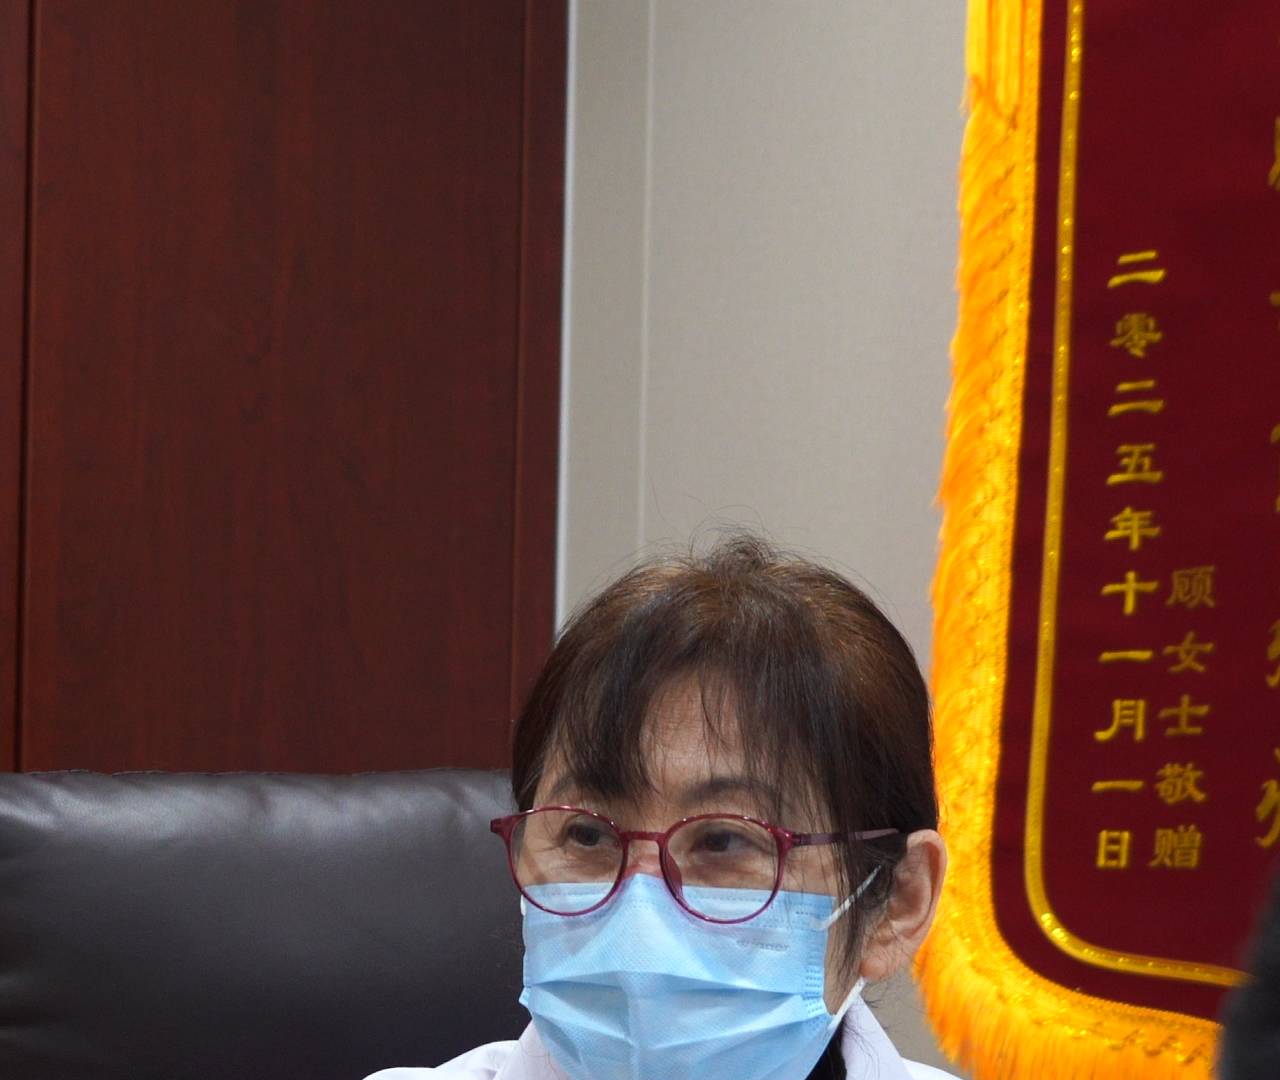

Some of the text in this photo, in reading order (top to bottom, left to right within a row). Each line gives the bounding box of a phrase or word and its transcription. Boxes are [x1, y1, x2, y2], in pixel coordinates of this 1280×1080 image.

[1091, 249, 1166, 869] 二零二五年十一月一日
[1149, 565, 1216, 869] 顾女士敬赠
